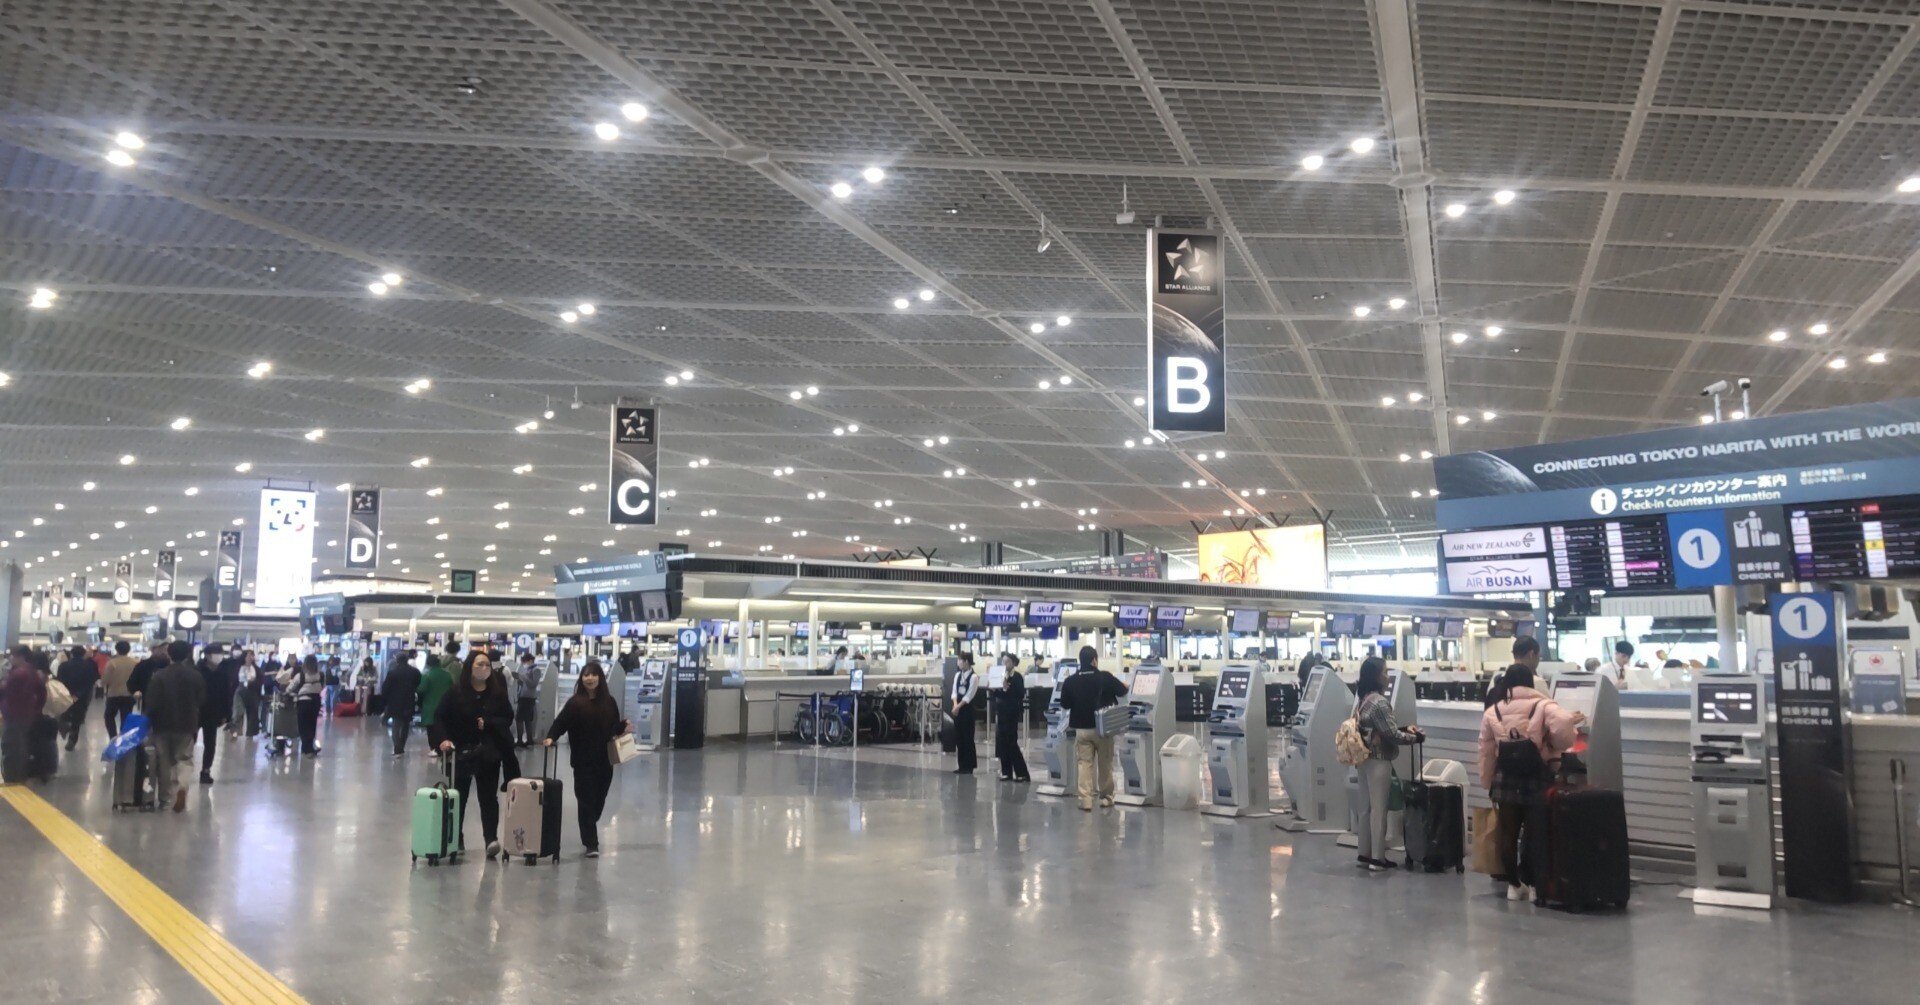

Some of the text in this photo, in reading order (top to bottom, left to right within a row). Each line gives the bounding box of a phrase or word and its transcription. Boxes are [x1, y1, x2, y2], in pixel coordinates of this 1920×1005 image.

[1167, 356, 1211, 413] B
[1533, 453, 1637, 474] CONNECTING
[1640, 446, 1699, 463] TOKYO
[1702, 438, 1768, 457] NARITA
[1770, 432, 1819, 449] WITH
[1822, 427, 1862, 444] THE
[617, 478, 650, 516] C
[1621, 473, 1788, 500] チェックインカウンター案内
[1621, 490, 1781, 512] Check-in Counters Information
[350, 537, 373, 563] D
[1452, 540, 1521, 551] AIR NEW ZEALAND
[1689, 535, 1705, 561] 1
[218, 565, 236, 586] E
[1466, 575, 1532, 588] AIR BUSAN
[157, 579, 172, 597] F
[32, 607, 41, 620] J
[72, 596, 84, 611] H
[1793, 604, 1808, 631] 1
